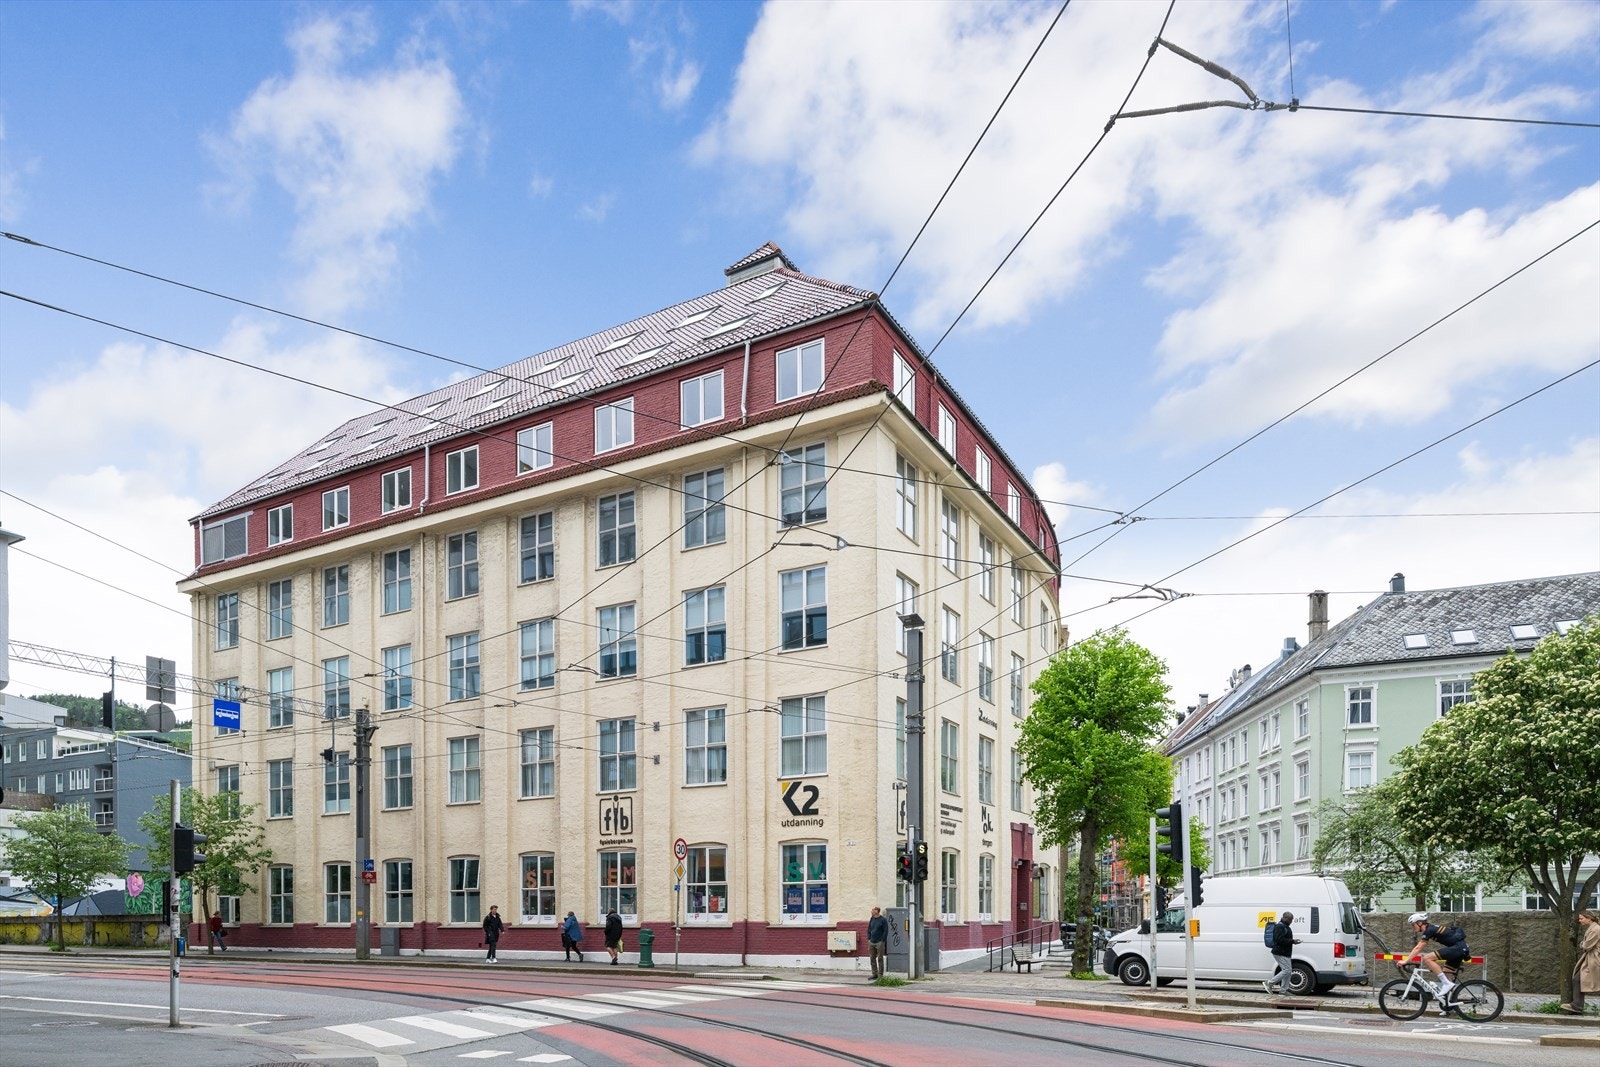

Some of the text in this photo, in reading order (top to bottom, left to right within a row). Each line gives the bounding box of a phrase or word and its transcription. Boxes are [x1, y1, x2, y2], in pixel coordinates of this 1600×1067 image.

[781, 781, 820, 817] K2
[781, 818, 824, 828] utdanning
[676, 843, 686, 855] 30
[919, 844, 925, 854] S
